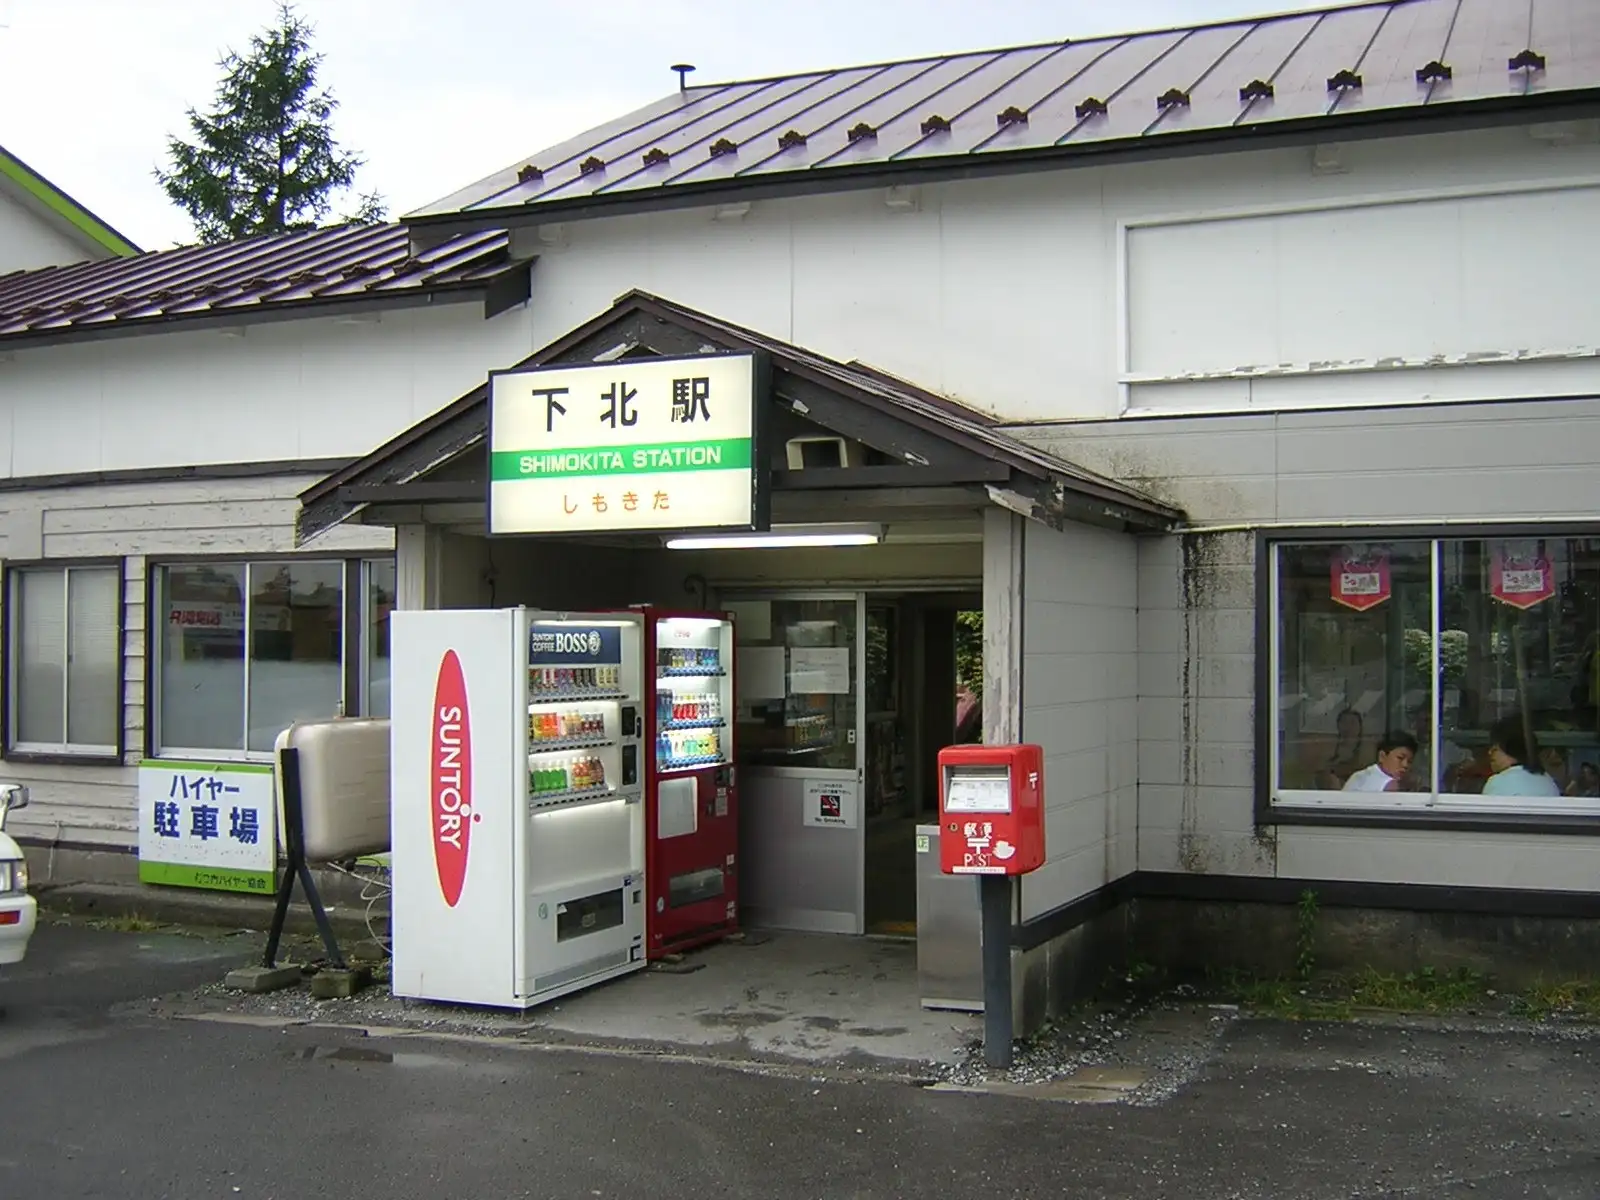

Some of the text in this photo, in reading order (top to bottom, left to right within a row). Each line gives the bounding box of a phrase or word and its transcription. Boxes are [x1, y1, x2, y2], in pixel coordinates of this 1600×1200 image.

[532, 377, 711, 432] 下北駅
[519, 445, 722, 474] SHIMOKITA STATION
[563, 490, 670, 514] しもきた
[532, 633, 588, 653] COFFEE BOSS
[170, 775, 241, 800] ハイヤー
[439, 706, 463, 850] SUNTORY
[154, 802, 259, 844] 駐車場
[964, 822, 992, 838] 郵便
